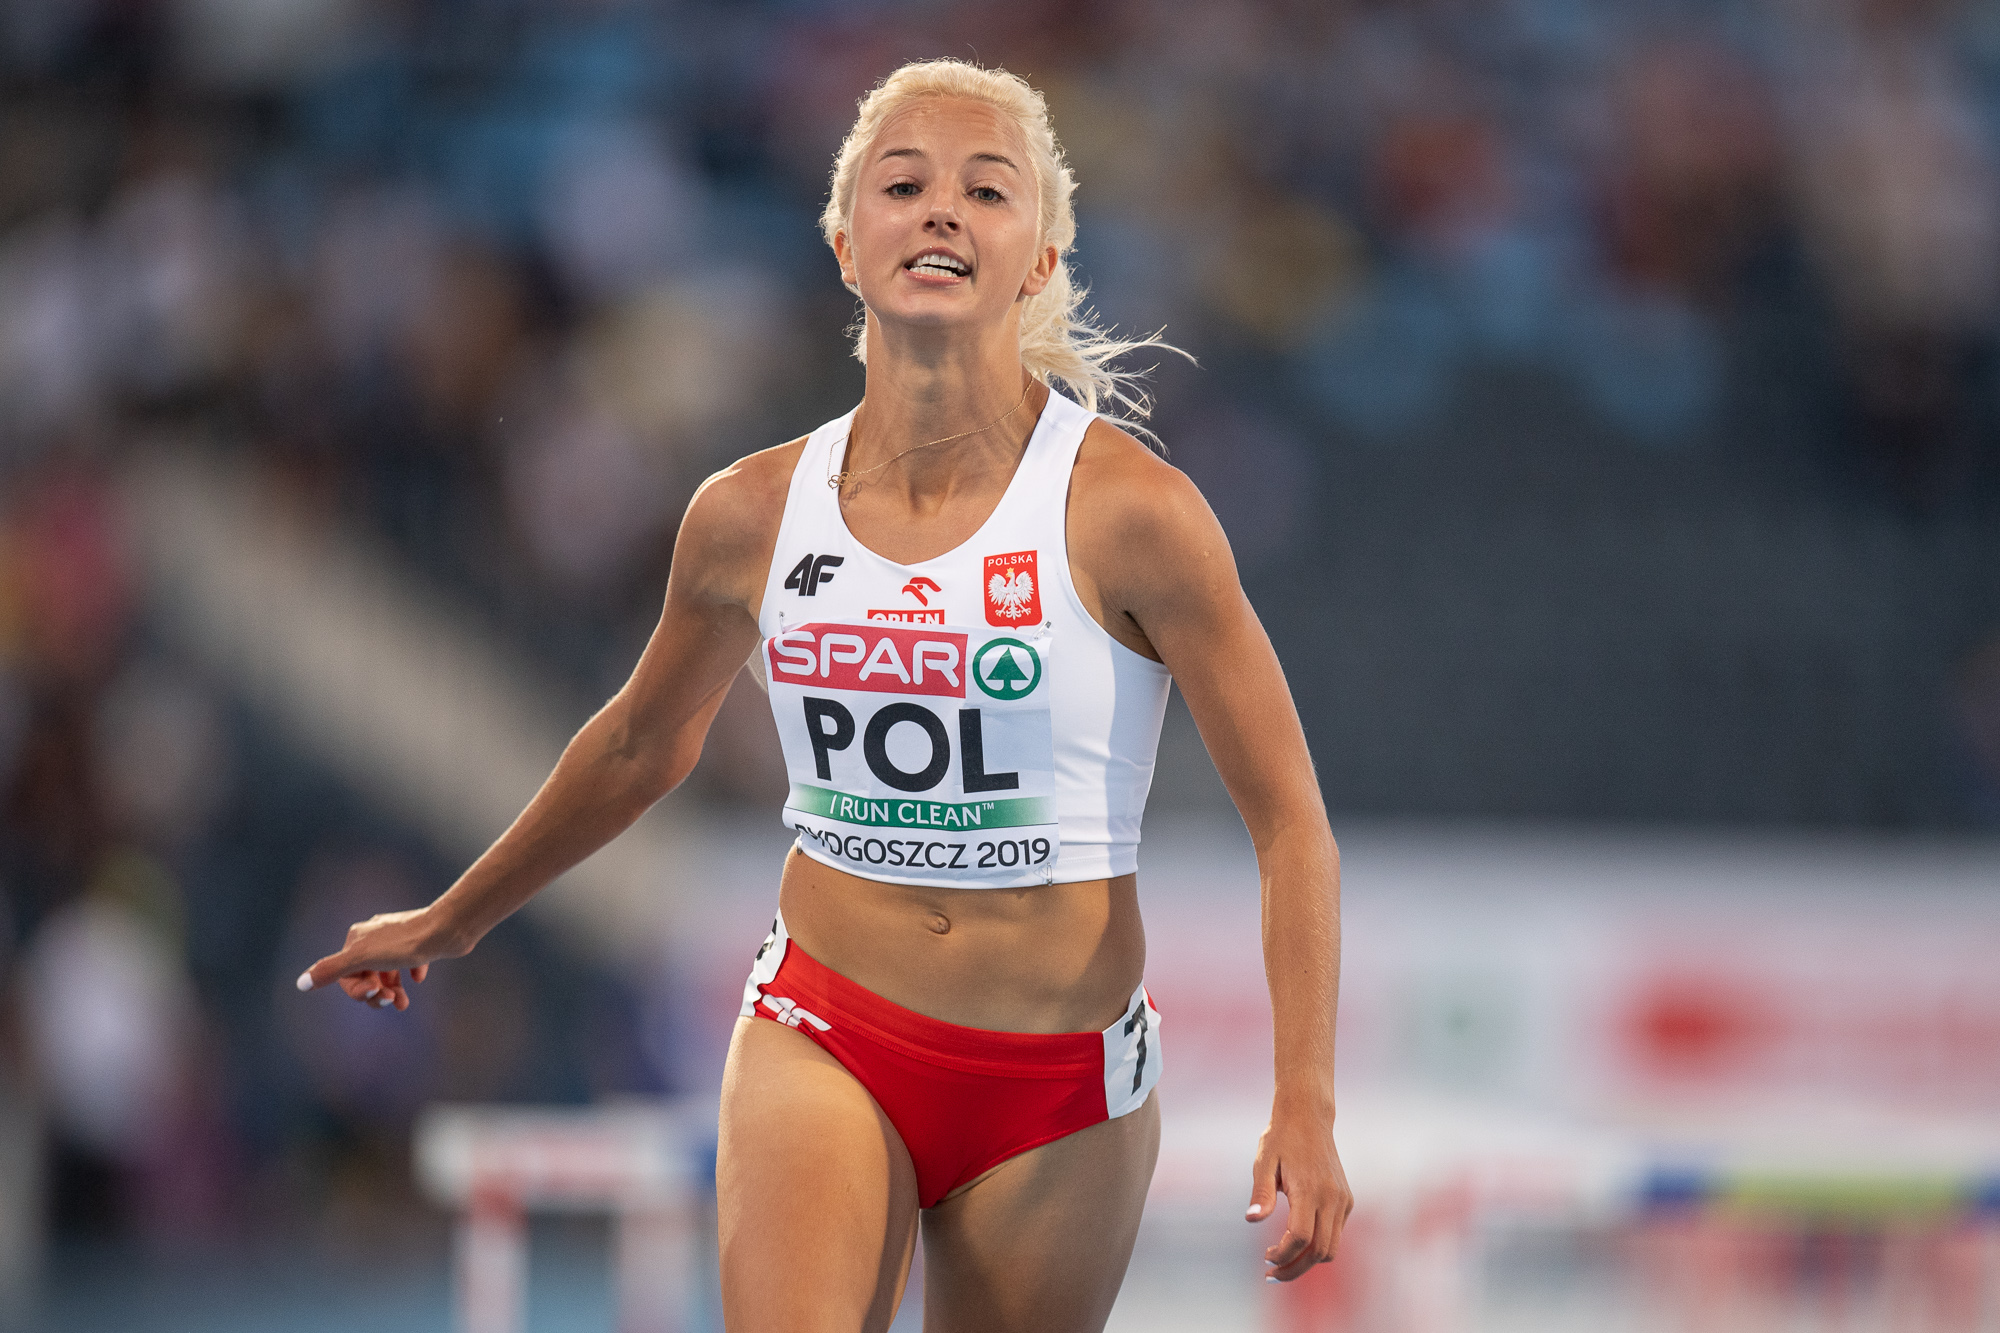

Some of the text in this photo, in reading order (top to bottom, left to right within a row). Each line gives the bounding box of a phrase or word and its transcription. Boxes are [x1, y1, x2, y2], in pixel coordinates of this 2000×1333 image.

[784, 553, 845, 597] 4F
[987, 554, 1033, 567] POLSKA
[775, 631, 960, 688] SPAR
[803, 696, 1019, 794] POL
[839, 797, 889, 822] RUN
[977, 837, 1051, 869] 2019
